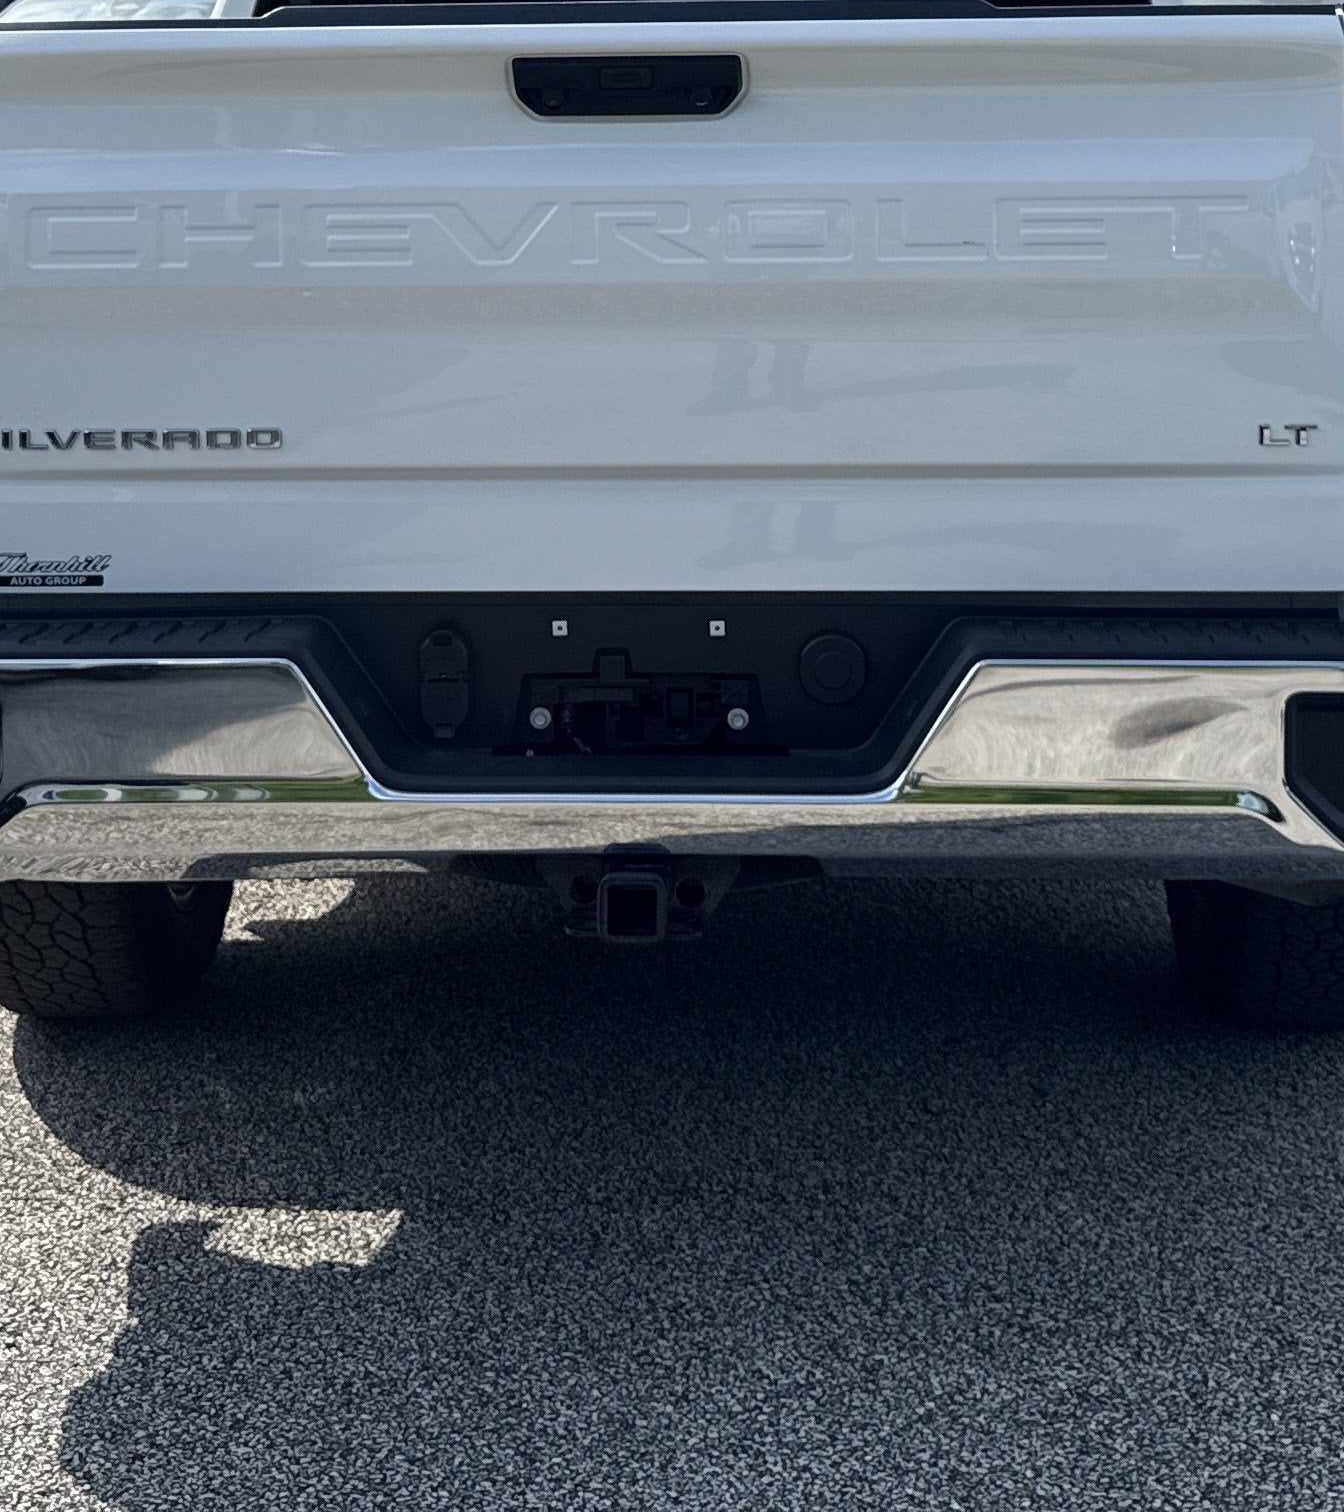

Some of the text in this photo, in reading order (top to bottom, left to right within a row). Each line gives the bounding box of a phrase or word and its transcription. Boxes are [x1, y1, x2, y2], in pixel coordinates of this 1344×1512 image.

[26, 194, 1250, 269] CHEVROLET
[1258, 423, 1319, 446] LT
[10, 576, 87, 586] AUTO GROUP
